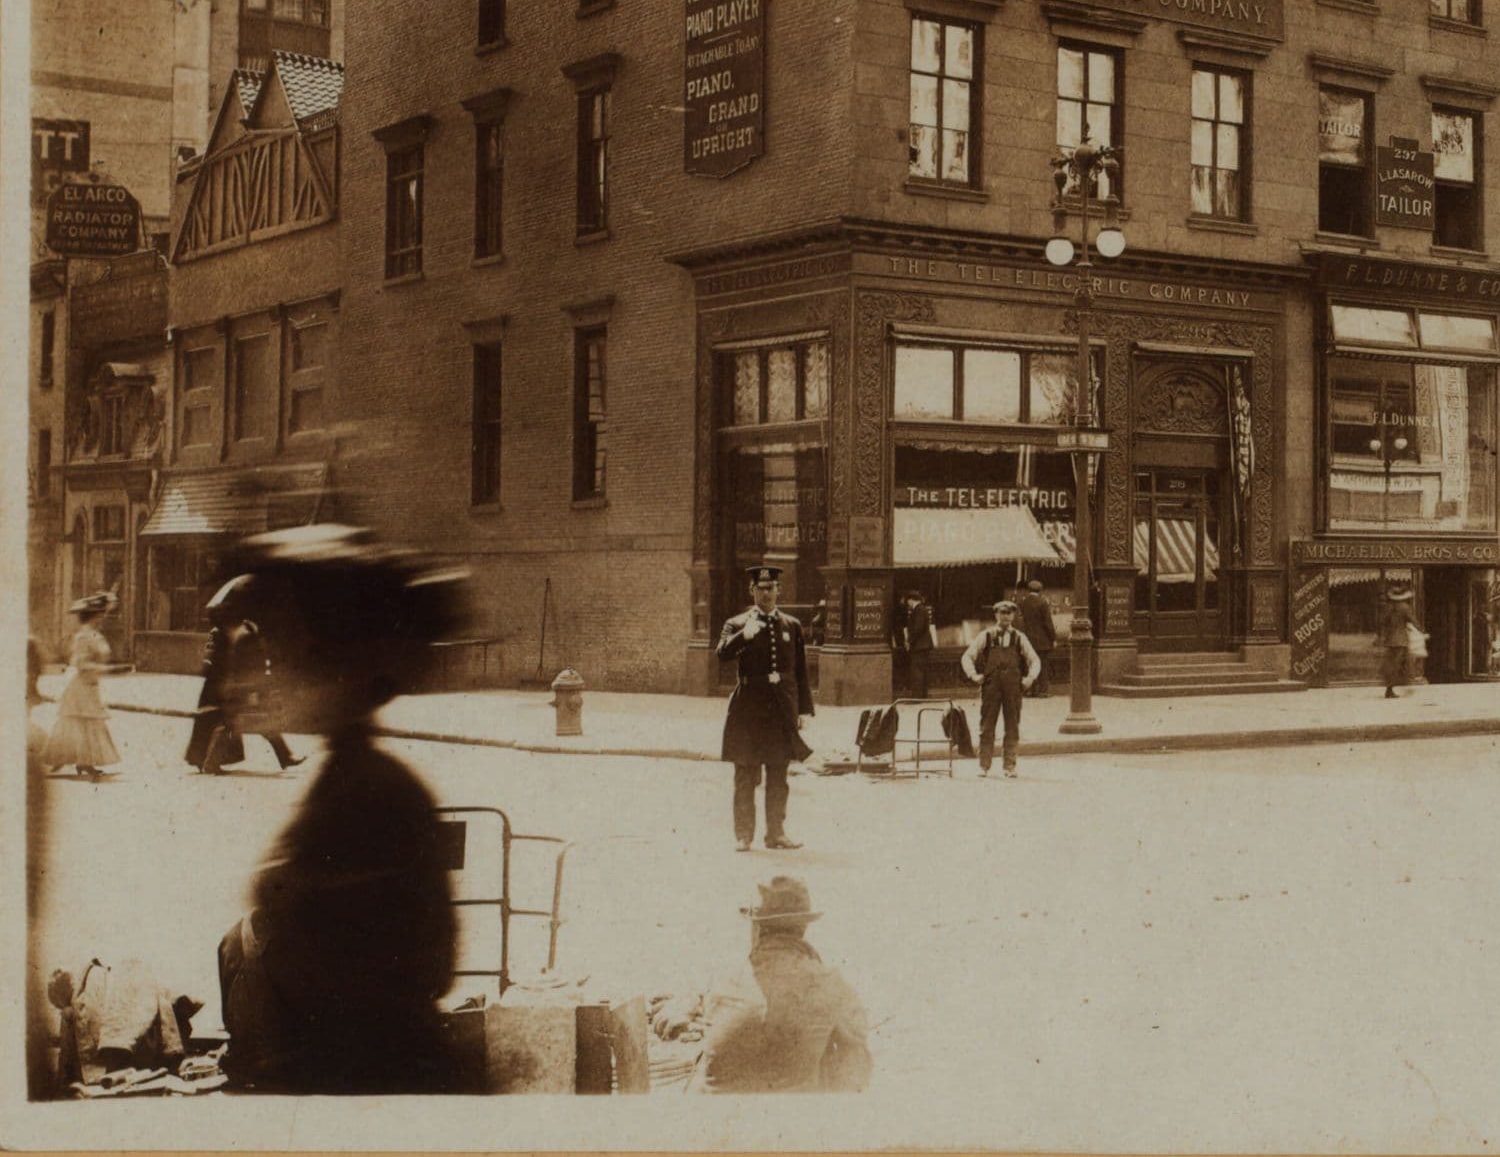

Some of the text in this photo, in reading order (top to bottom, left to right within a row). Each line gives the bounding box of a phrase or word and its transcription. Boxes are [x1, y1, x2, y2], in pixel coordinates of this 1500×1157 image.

[685, 7, 715, 41] PIANO
[708, 92, 760, 125] GRAND
[691, 125, 756, 160] UPRIGHT
[1393, 147, 1418, 162] 297
[83, 185, 128, 203] ARCO
[1378, 193, 1433, 218] TAILOR
[53, 209, 134, 226] RADIATOR
[57, 223, 130, 240] COMPANY
[888, 256, 938, 276] THE
[1015, 269, 1130, 295] ELECRIC
[1149, 282, 1251, 307] COMPANY
[906, 486, 1069, 510] THE TEL-ELECTRIC
[1413, 543, 1452, 560] BROS
[1293, 612, 1326, 643] RUGS
